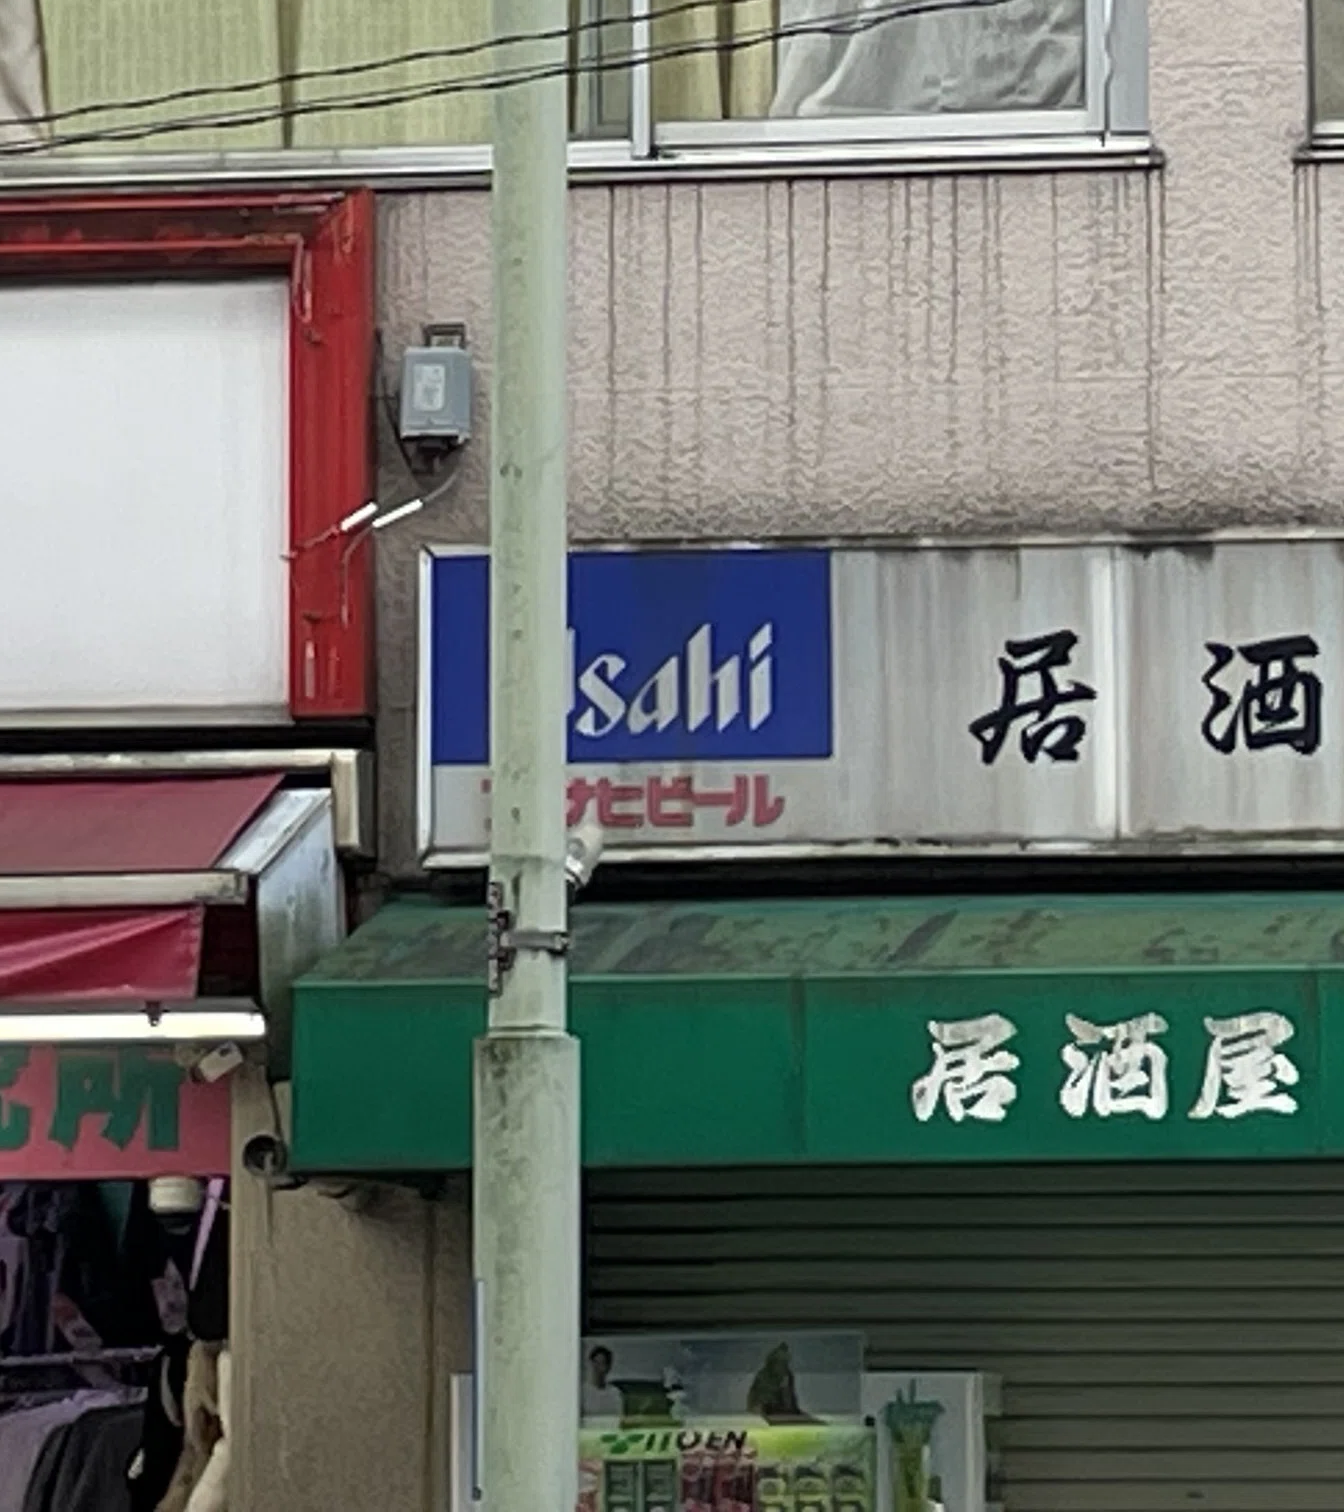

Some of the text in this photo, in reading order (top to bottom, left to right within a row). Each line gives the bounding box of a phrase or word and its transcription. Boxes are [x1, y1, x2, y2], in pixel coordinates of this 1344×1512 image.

[567, 622, 775, 739] sahi
[911, 1011, 1301, 1121] 居酒屋
